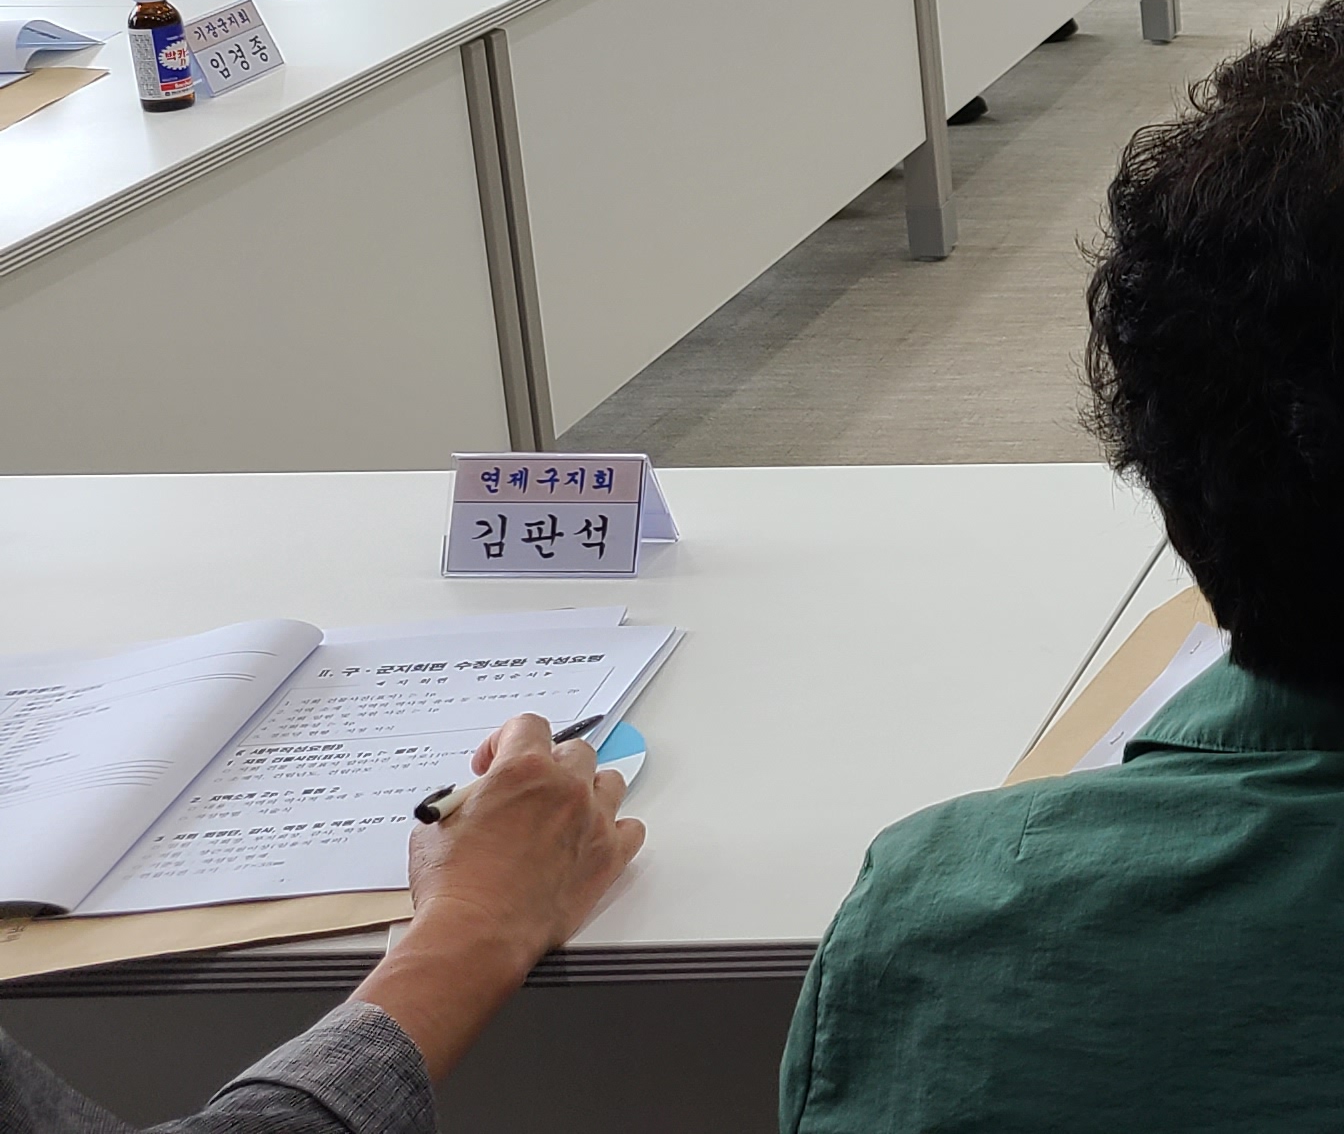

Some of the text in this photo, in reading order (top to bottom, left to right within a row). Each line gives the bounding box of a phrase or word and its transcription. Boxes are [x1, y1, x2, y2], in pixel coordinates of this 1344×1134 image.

[194, 8, 251, 42] 기장군지회
[210, 35, 269, 81] 임경종
[480, 466, 615, 495] 연제구지회
[471, 513, 609, 560] 김판석
[535, 654, 605, 666] 작성요령
